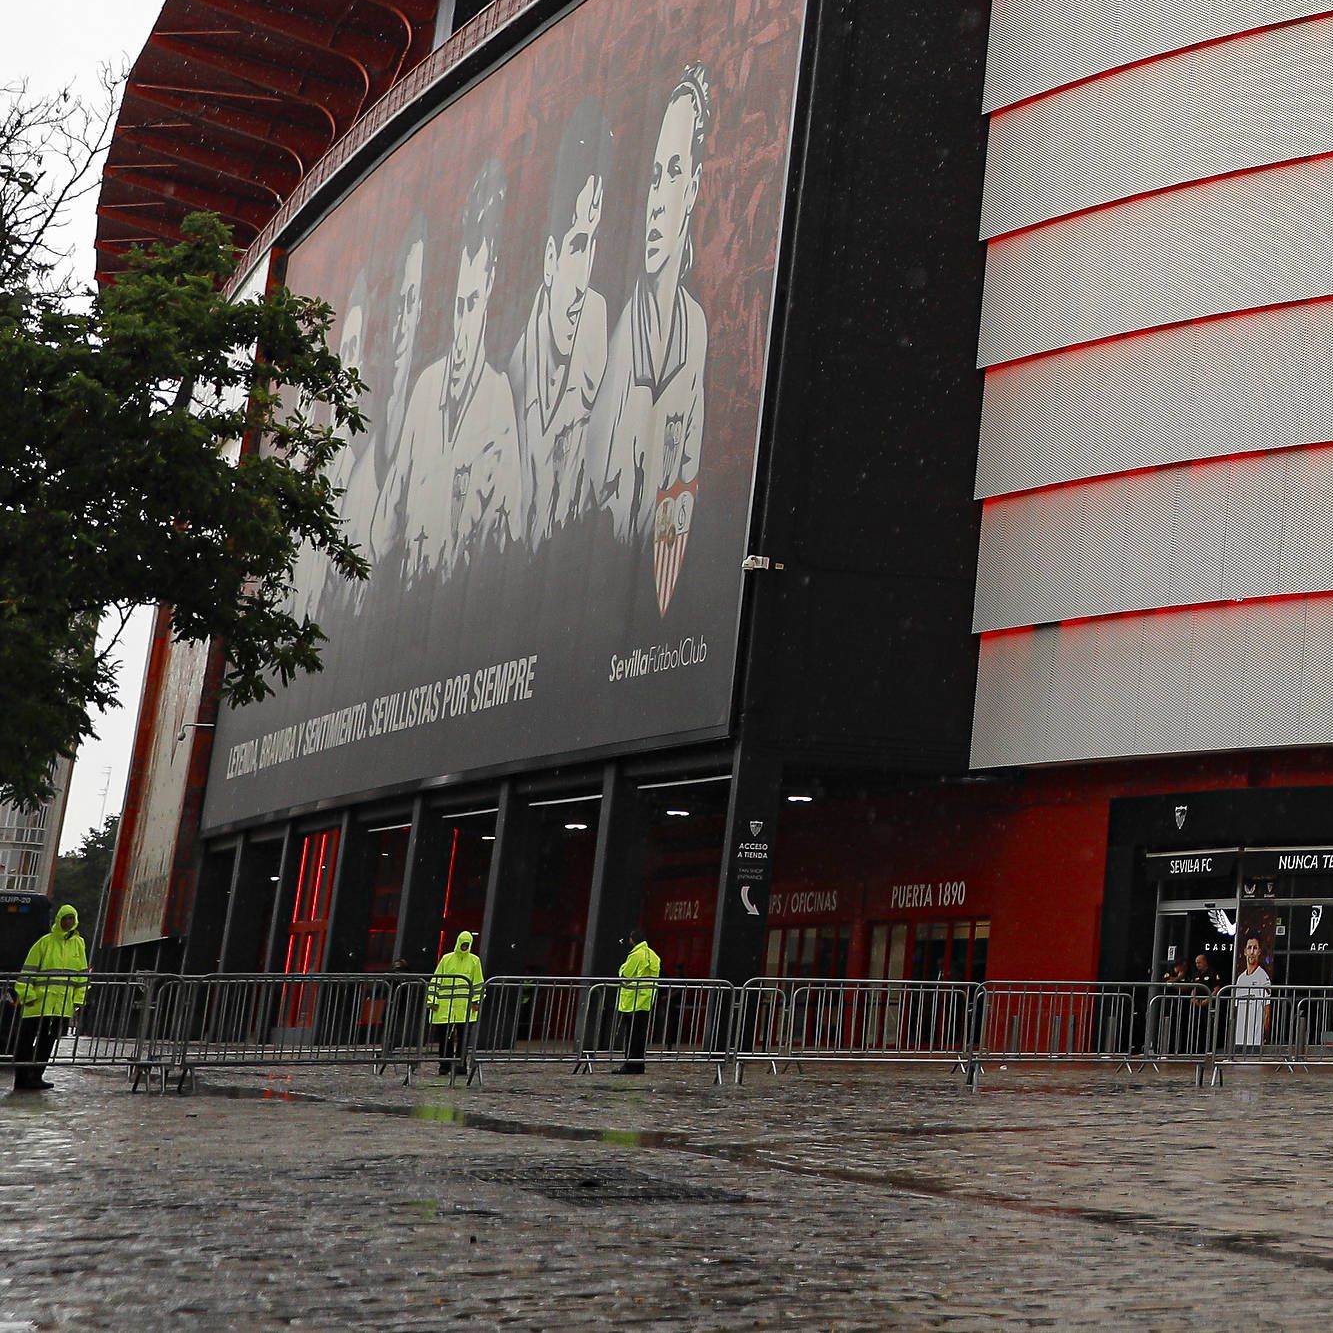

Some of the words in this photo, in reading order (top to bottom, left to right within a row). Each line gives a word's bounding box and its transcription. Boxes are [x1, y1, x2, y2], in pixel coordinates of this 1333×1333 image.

[369, 681, 442, 738] SEVILLISTAS
[441, 673, 471, 719] POR
[471, 654, 538, 713] SIEMPRE
[1170, 859, 1200, 874] SEVILLA
[1201, 858, 1213, 873] FC
[1278, 855, 1318, 870] NUNCA
[791, 890, 838, 913] OFICINAS
[891, 883, 933, 908] PUERTA
[938, 881, 966, 906] 1890
